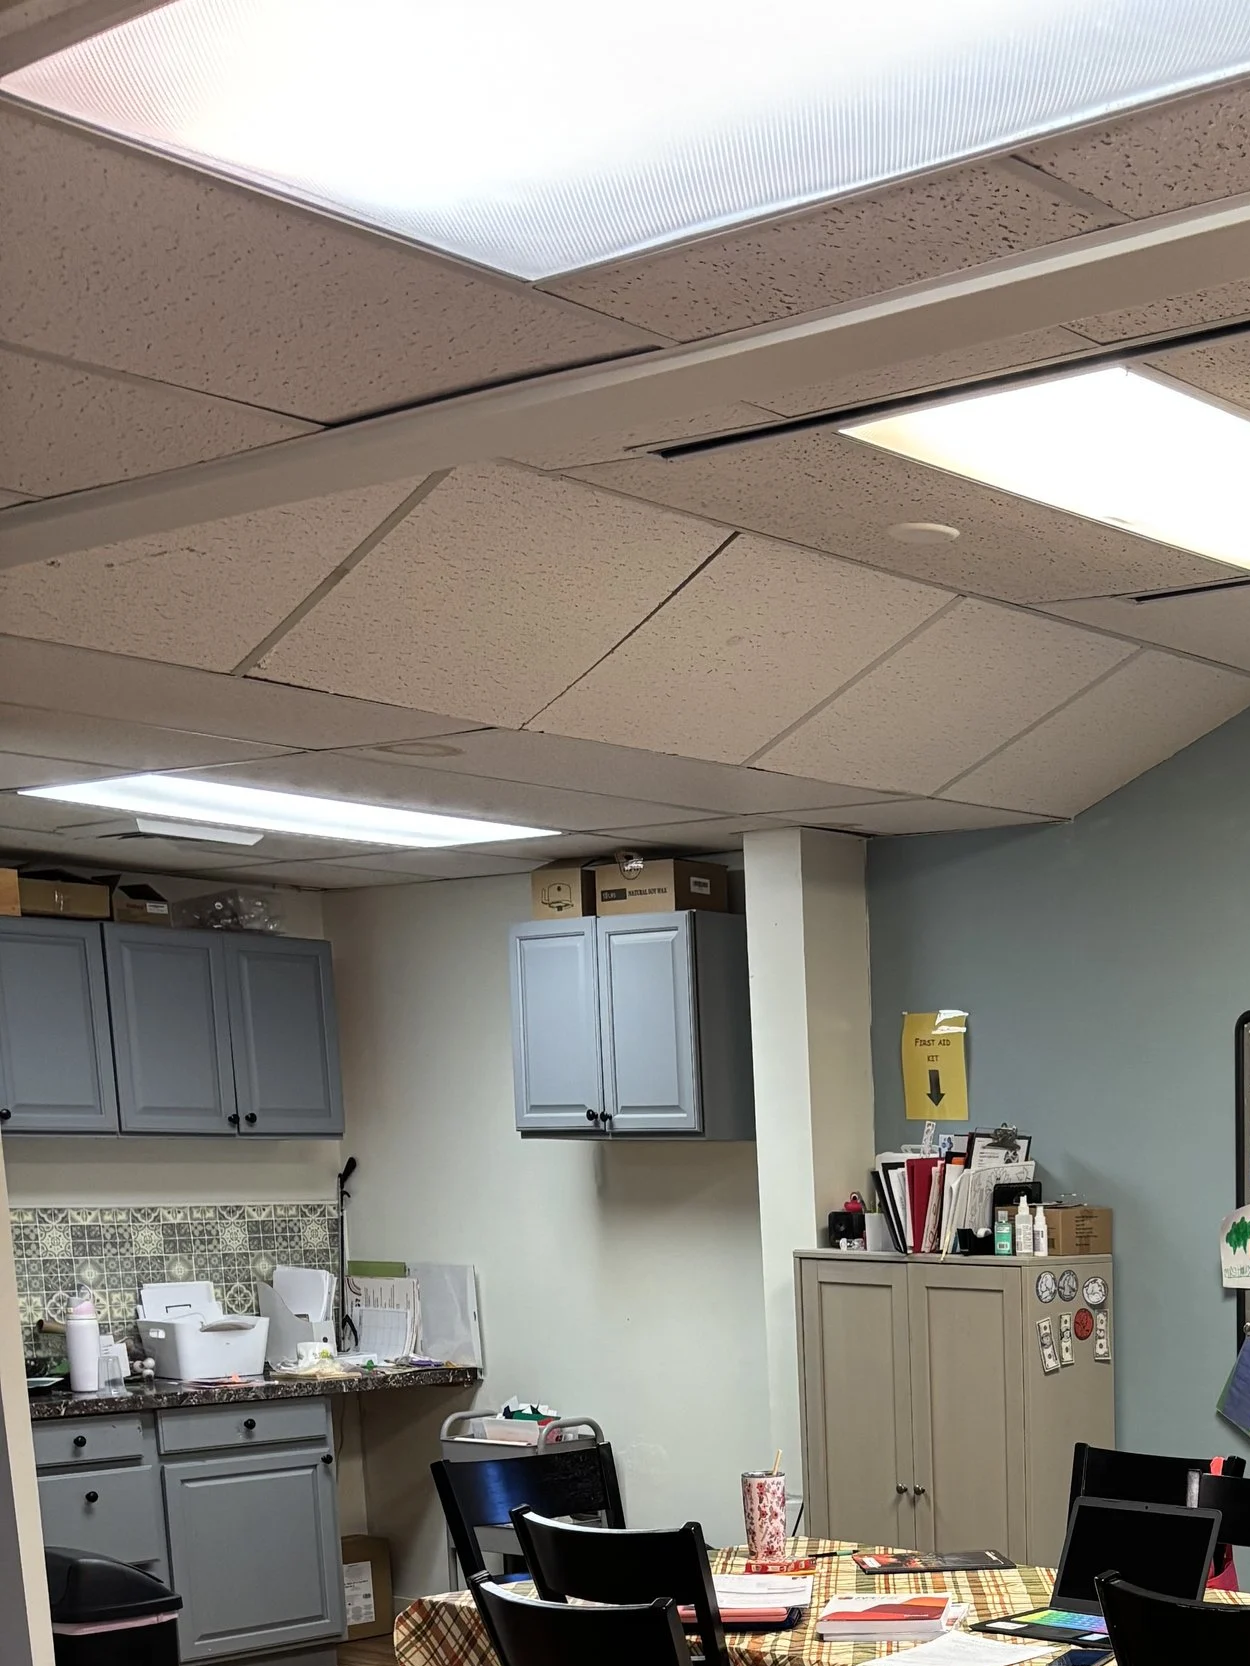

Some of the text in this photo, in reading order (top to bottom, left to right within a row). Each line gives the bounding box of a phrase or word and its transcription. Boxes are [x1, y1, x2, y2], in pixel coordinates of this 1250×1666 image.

[628, 889, 648, 897] NATURAL
[914, 1037, 951, 1047] FIRST AID
[927, 1054, 940, 1062] KIT
